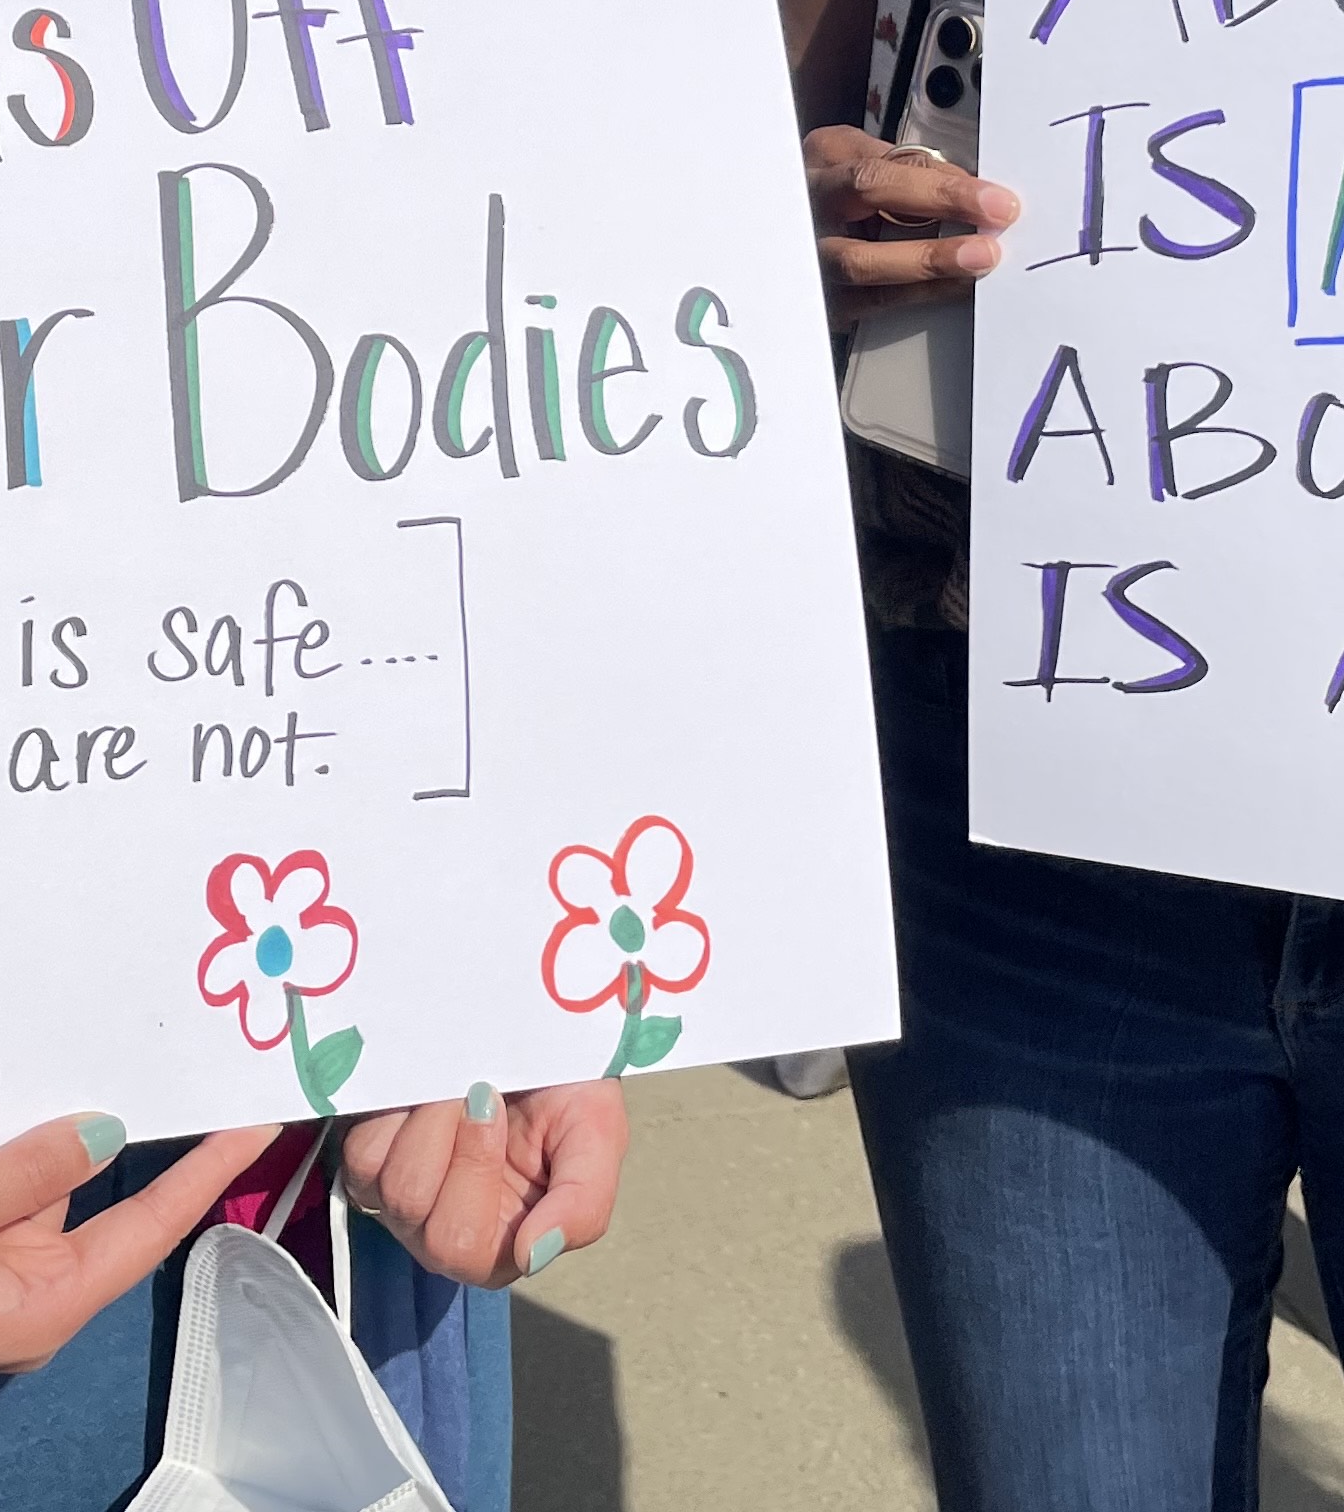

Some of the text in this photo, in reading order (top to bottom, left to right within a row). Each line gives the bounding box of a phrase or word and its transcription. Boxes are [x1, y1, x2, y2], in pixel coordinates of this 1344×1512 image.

[1025, 102, 1257, 272] IS
[157, 162, 759, 504] Bodies
[19, 595, 89, 690] is
[1002, 559, 1209, 704] IS
[8, 724, 148, 794] are
[192, 711, 337, 787] not.
